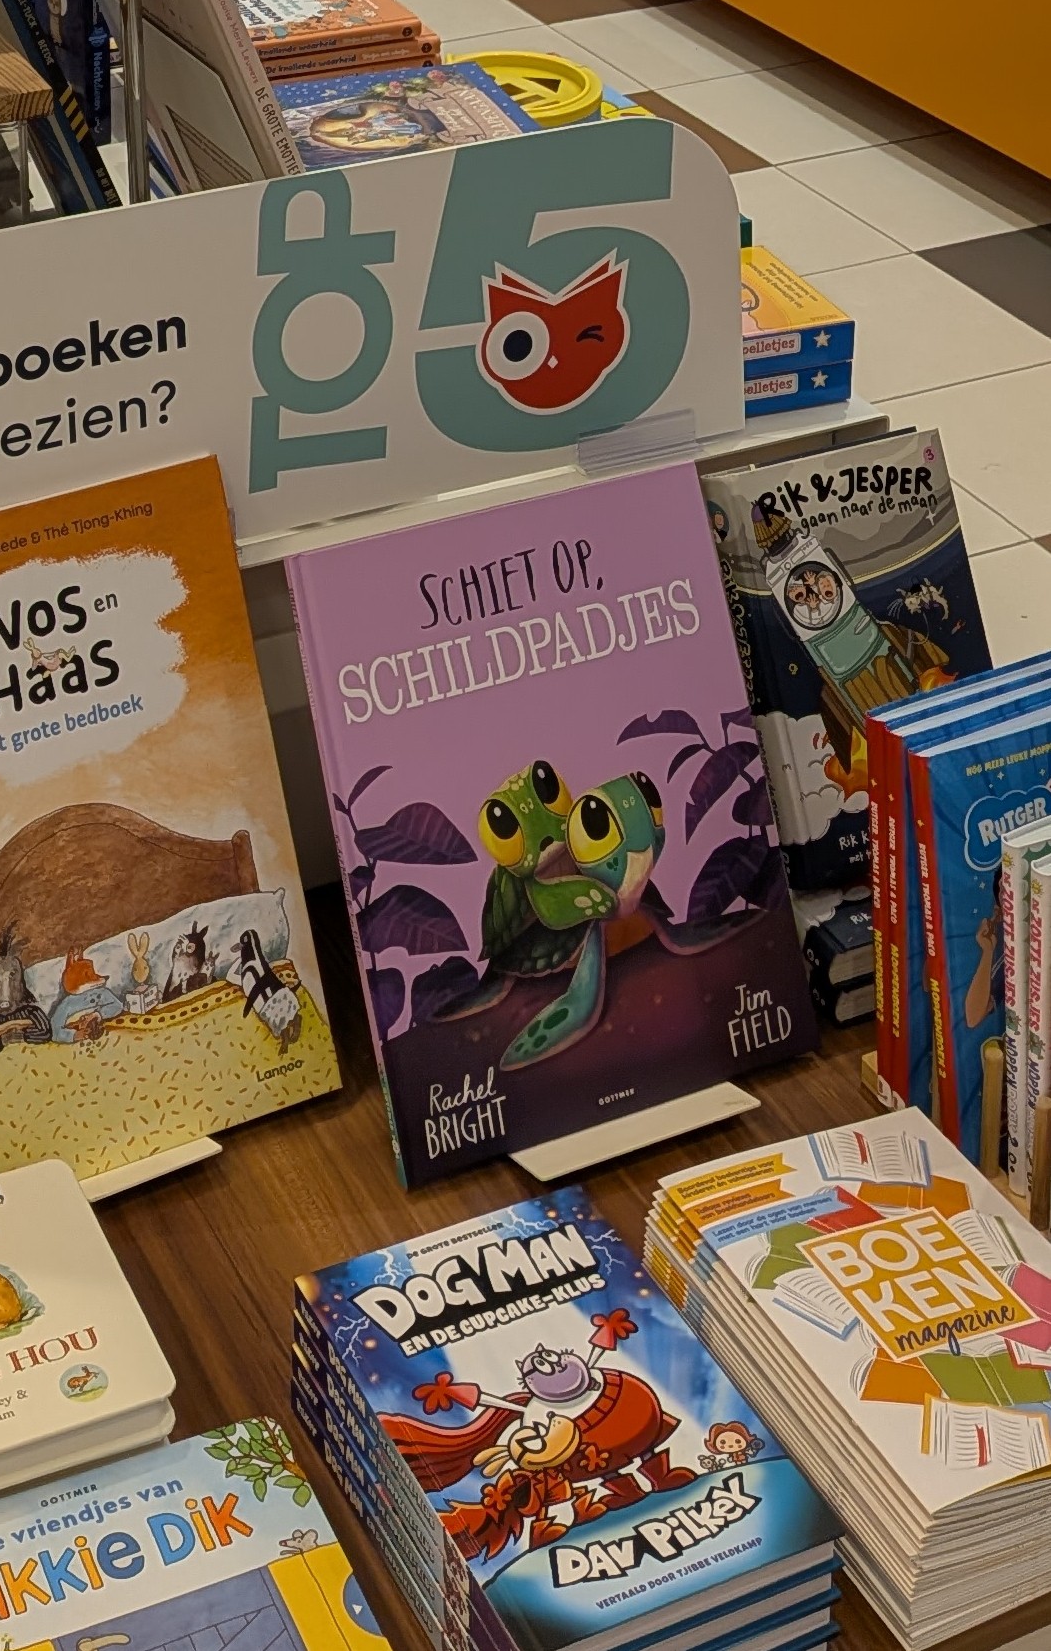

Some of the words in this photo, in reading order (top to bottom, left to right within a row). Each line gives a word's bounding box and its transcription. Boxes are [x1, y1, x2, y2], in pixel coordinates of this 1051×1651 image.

[254, 86, 267, 104] DE
[262, 104, 284, 138] GROTE
[247, 168, 397, 495] TOP
[413, 117, 692, 454] 5
[800, 511, 838, 537] gaan
[840, 500, 874, 522] naar
[876, 494, 896, 516] de
[896, 491, 939, 514] maan
[418, 545, 540, 632] SCHIET
[551, 538, 605, 594] OP,
[338, 577, 702, 726] SCHILDPADJES
[11, 716, 62, 755] grote
[64, 693, 145, 734] bedboek
[978, 796, 1048, 847] RUTGER
[732, 984, 774, 1018] Jim
[726, 1012, 793, 1058] FIELD
[254, 1057, 305, 1084] Lannoo
[428, 1065, 499, 1115] Rachel
[423, 1096, 509, 1160] BRIGHT
[351, 1256, 477, 1340] DOG
[481, 1223, 596, 1293] MAN
[811, 1215, 967, 1288] BOE
[400, 1334, 433, 1357] EN
[434, 1325, 460, 1346] DE
[460, 1273, 607, 1336] CUPCAKE-KLUS
[852, 1258, 1004, 1332] KEN
[5, 1323, 104, 1378] HOU
[894, 1303, 1016, 1357] magazine
[6, 1497, 133, 1548] vriendjes
[135, 1476, 186, 1506] van
